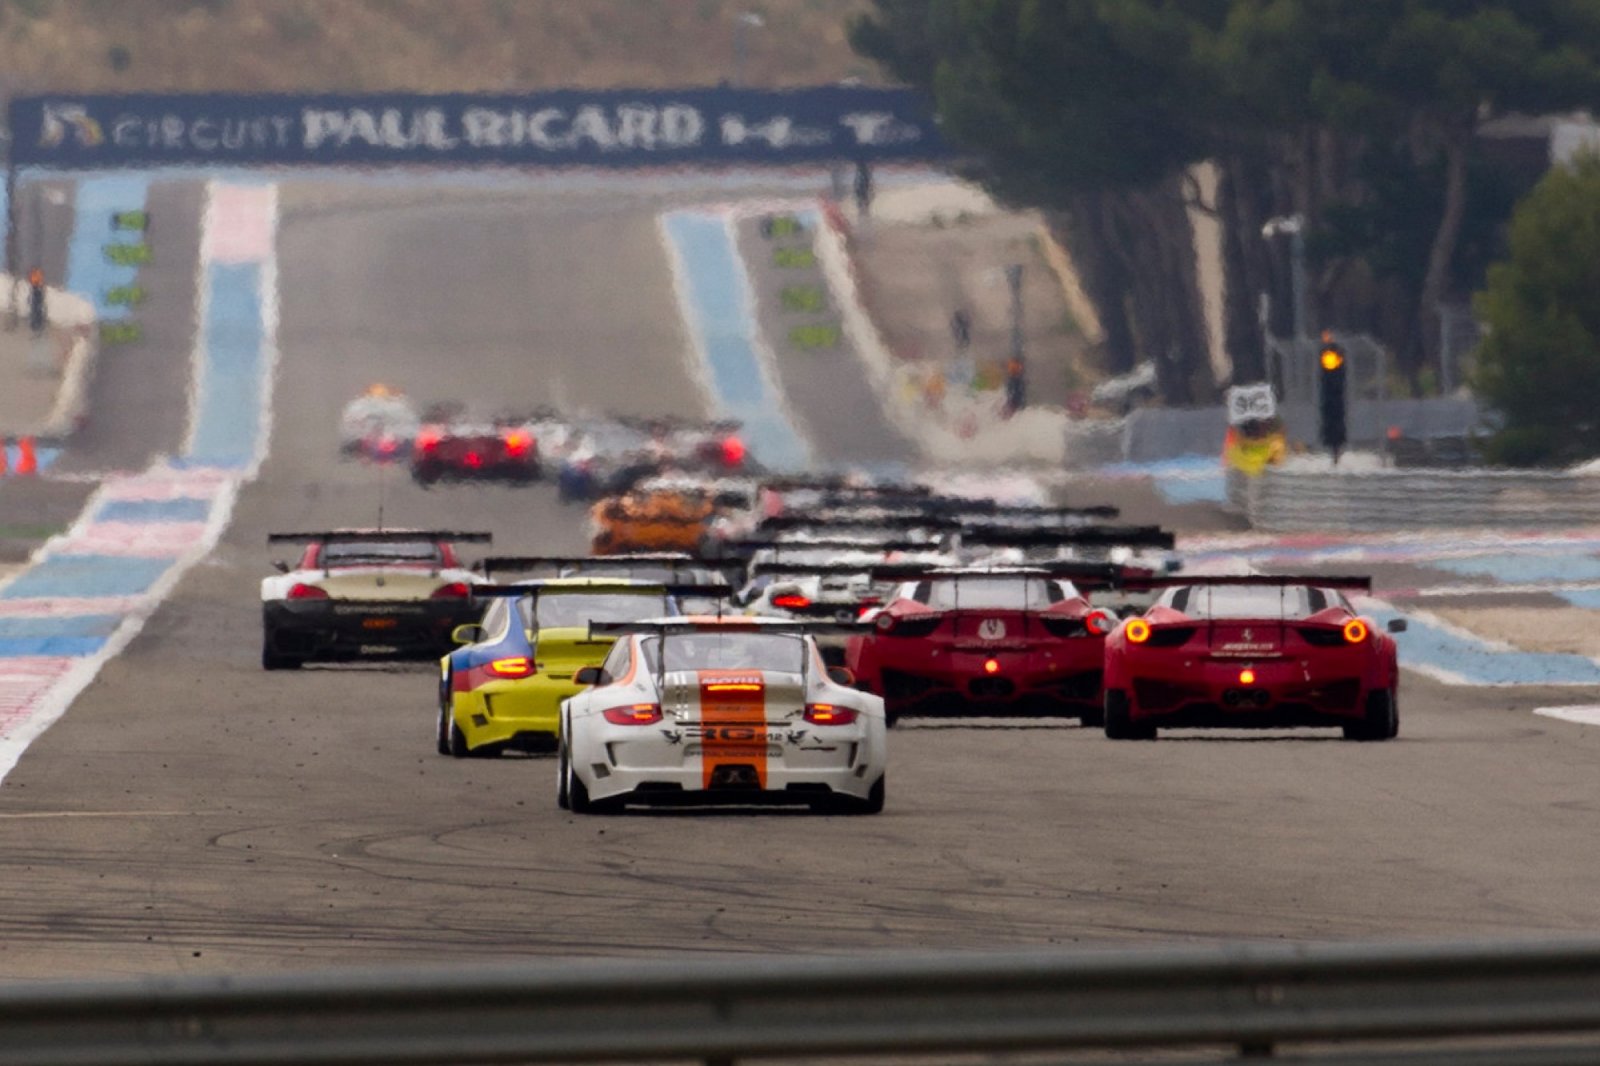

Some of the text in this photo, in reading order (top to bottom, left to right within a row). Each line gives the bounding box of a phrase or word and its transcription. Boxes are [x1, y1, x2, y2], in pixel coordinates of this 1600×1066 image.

[111, 113, 294, 150] CIRCUIT
[303, 106, 459, 150] PAUL
[462, 102, 703, 151] RICARD
